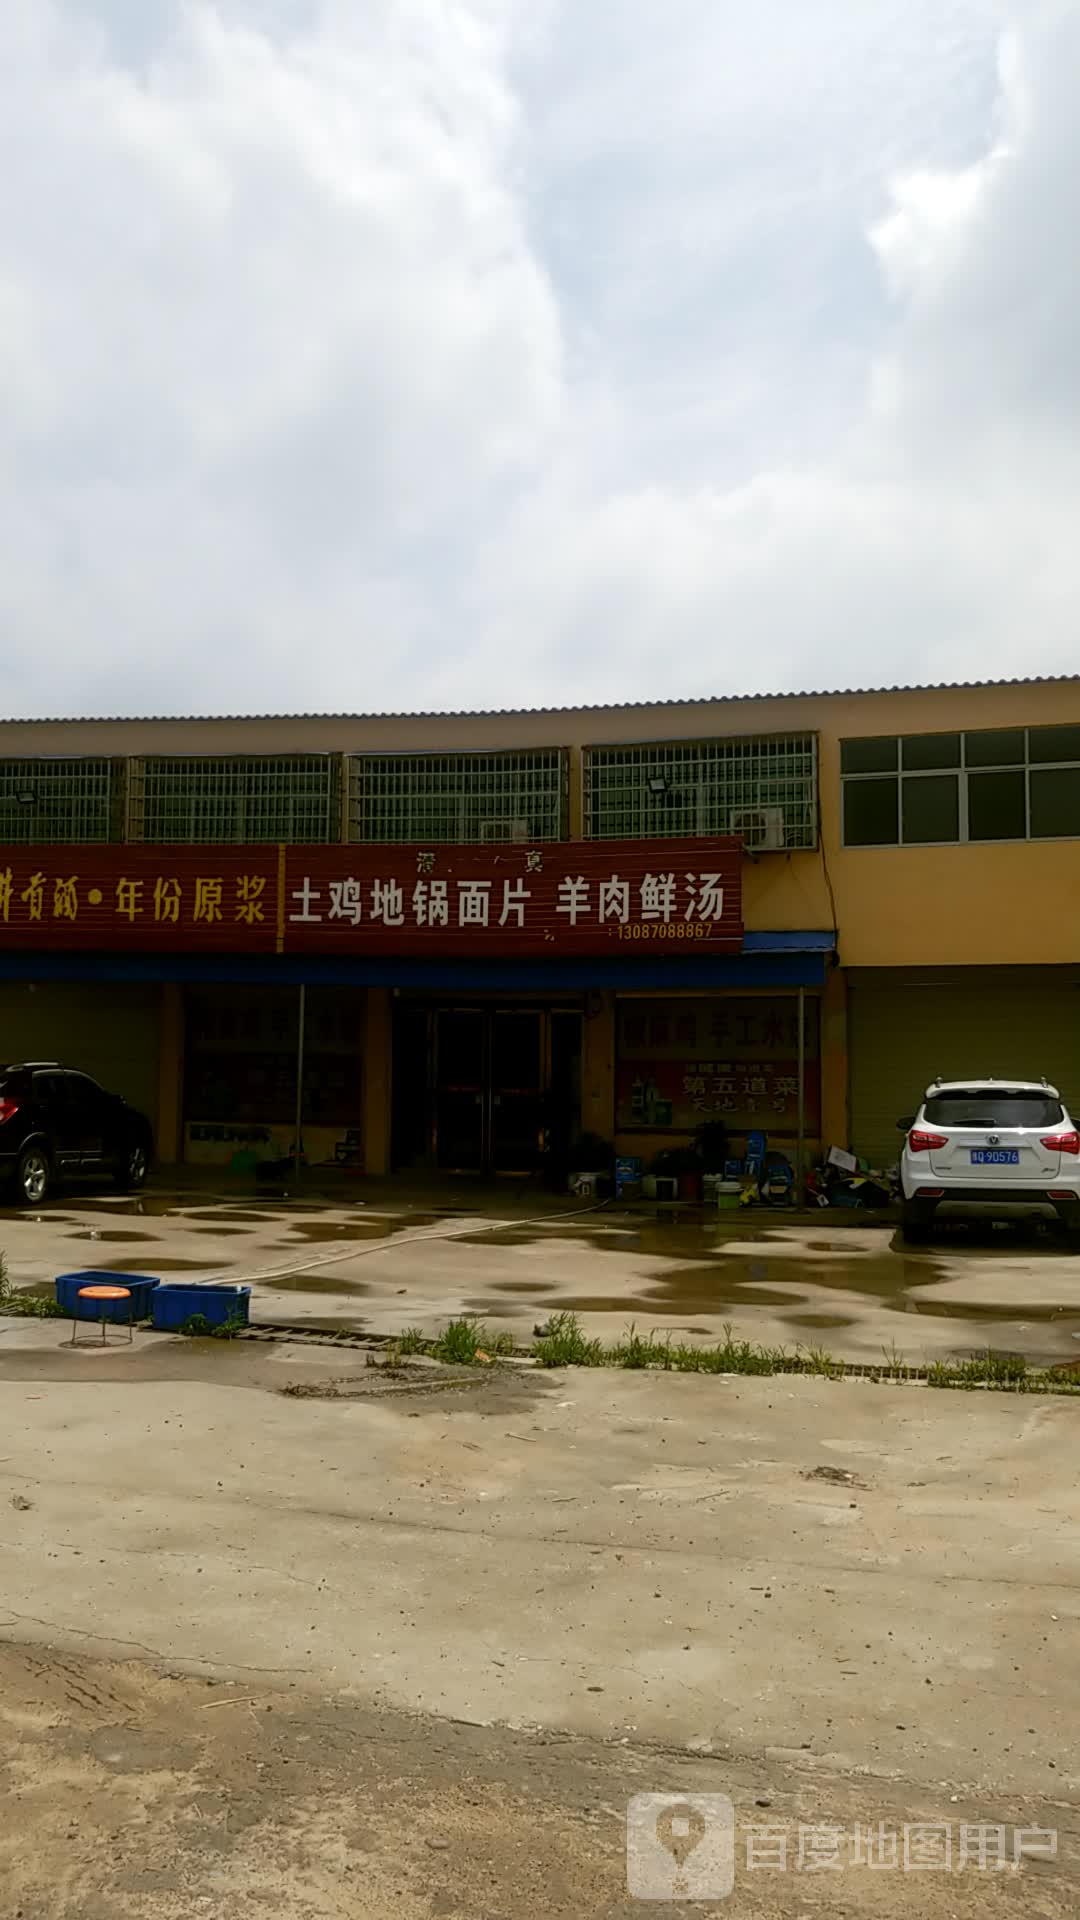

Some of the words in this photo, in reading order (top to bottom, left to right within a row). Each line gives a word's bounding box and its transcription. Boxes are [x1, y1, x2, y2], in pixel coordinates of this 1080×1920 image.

[289, 875, 532, 928] 土鸡地锅面片
[556, 872, 725, 927] 羊肉鲜汤
[680, 1075, 799, 1097] 第五道菜
